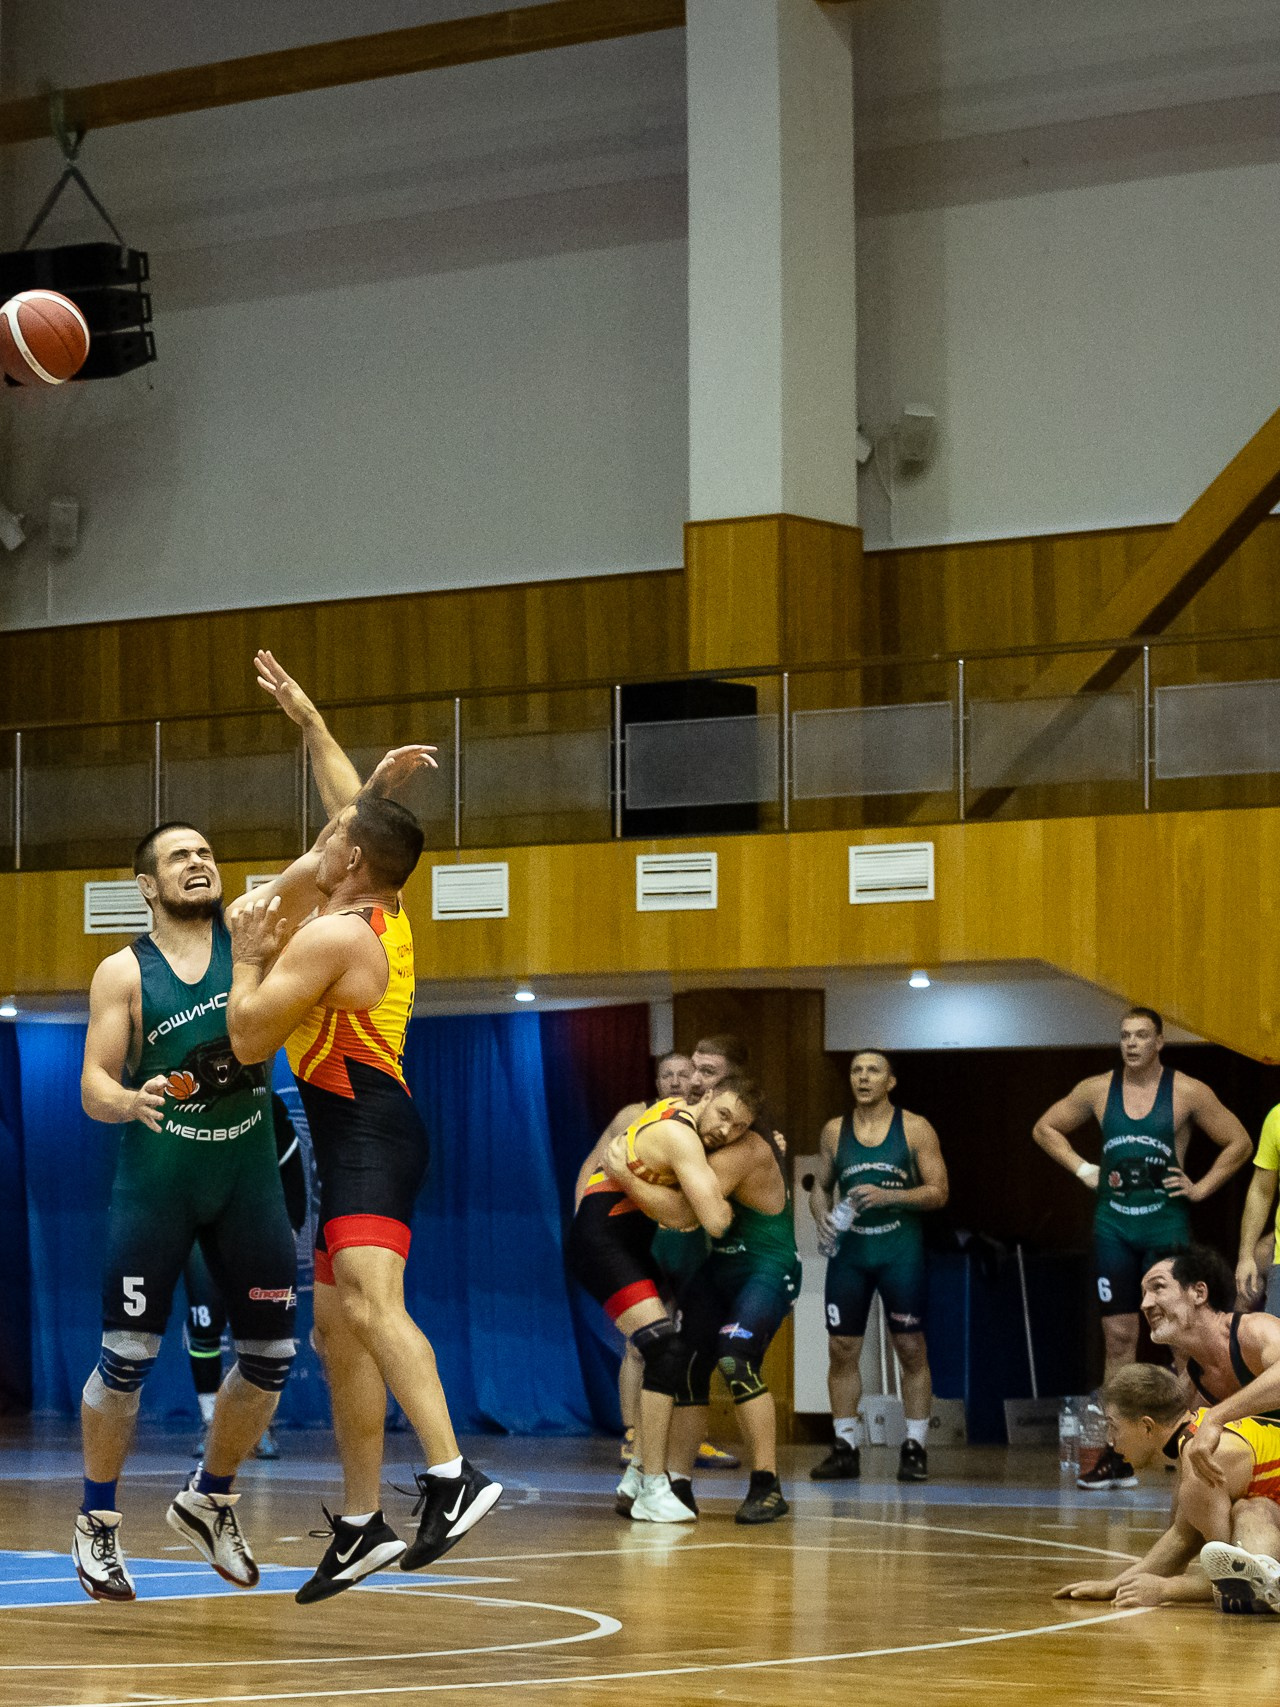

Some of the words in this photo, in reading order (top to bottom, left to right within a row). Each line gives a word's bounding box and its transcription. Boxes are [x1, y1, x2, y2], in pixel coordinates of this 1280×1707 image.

[146, 992, 229, 1046] РОЩИНС
[165, 1109, 262, 1141] МЕДВЕДИ
[122, 1276, 147, 1317] 5
[1097, 1276, 1113, 1303] 6
[190, 1304, 212, 1328] 18
[827, 1303, 841, 1328] 9
